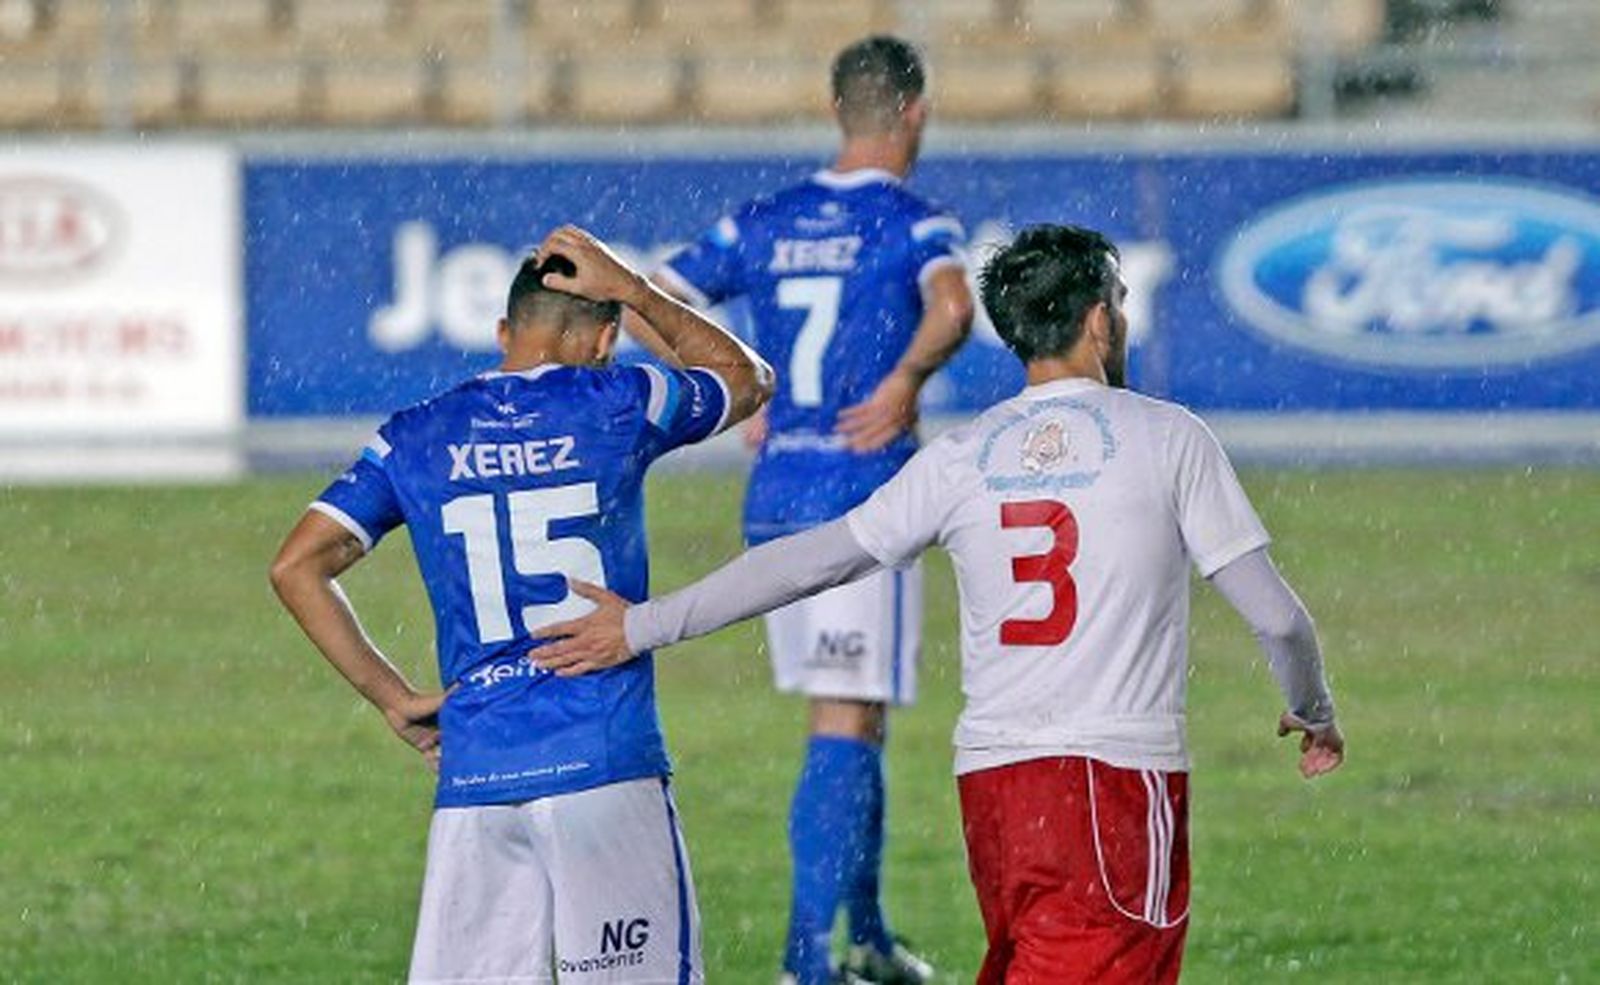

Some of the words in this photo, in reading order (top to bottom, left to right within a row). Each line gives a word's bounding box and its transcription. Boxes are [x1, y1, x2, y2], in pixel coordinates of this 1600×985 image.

[769, 234, 862, 273] XEREZ
[776, 274, 843, 408] 7
[448, 435, 580, 481] XEREZ
[441, 482, 607, 644] 15
[1001, 499, 1079, 646] 3
[601, 918, 649, 954] NG
